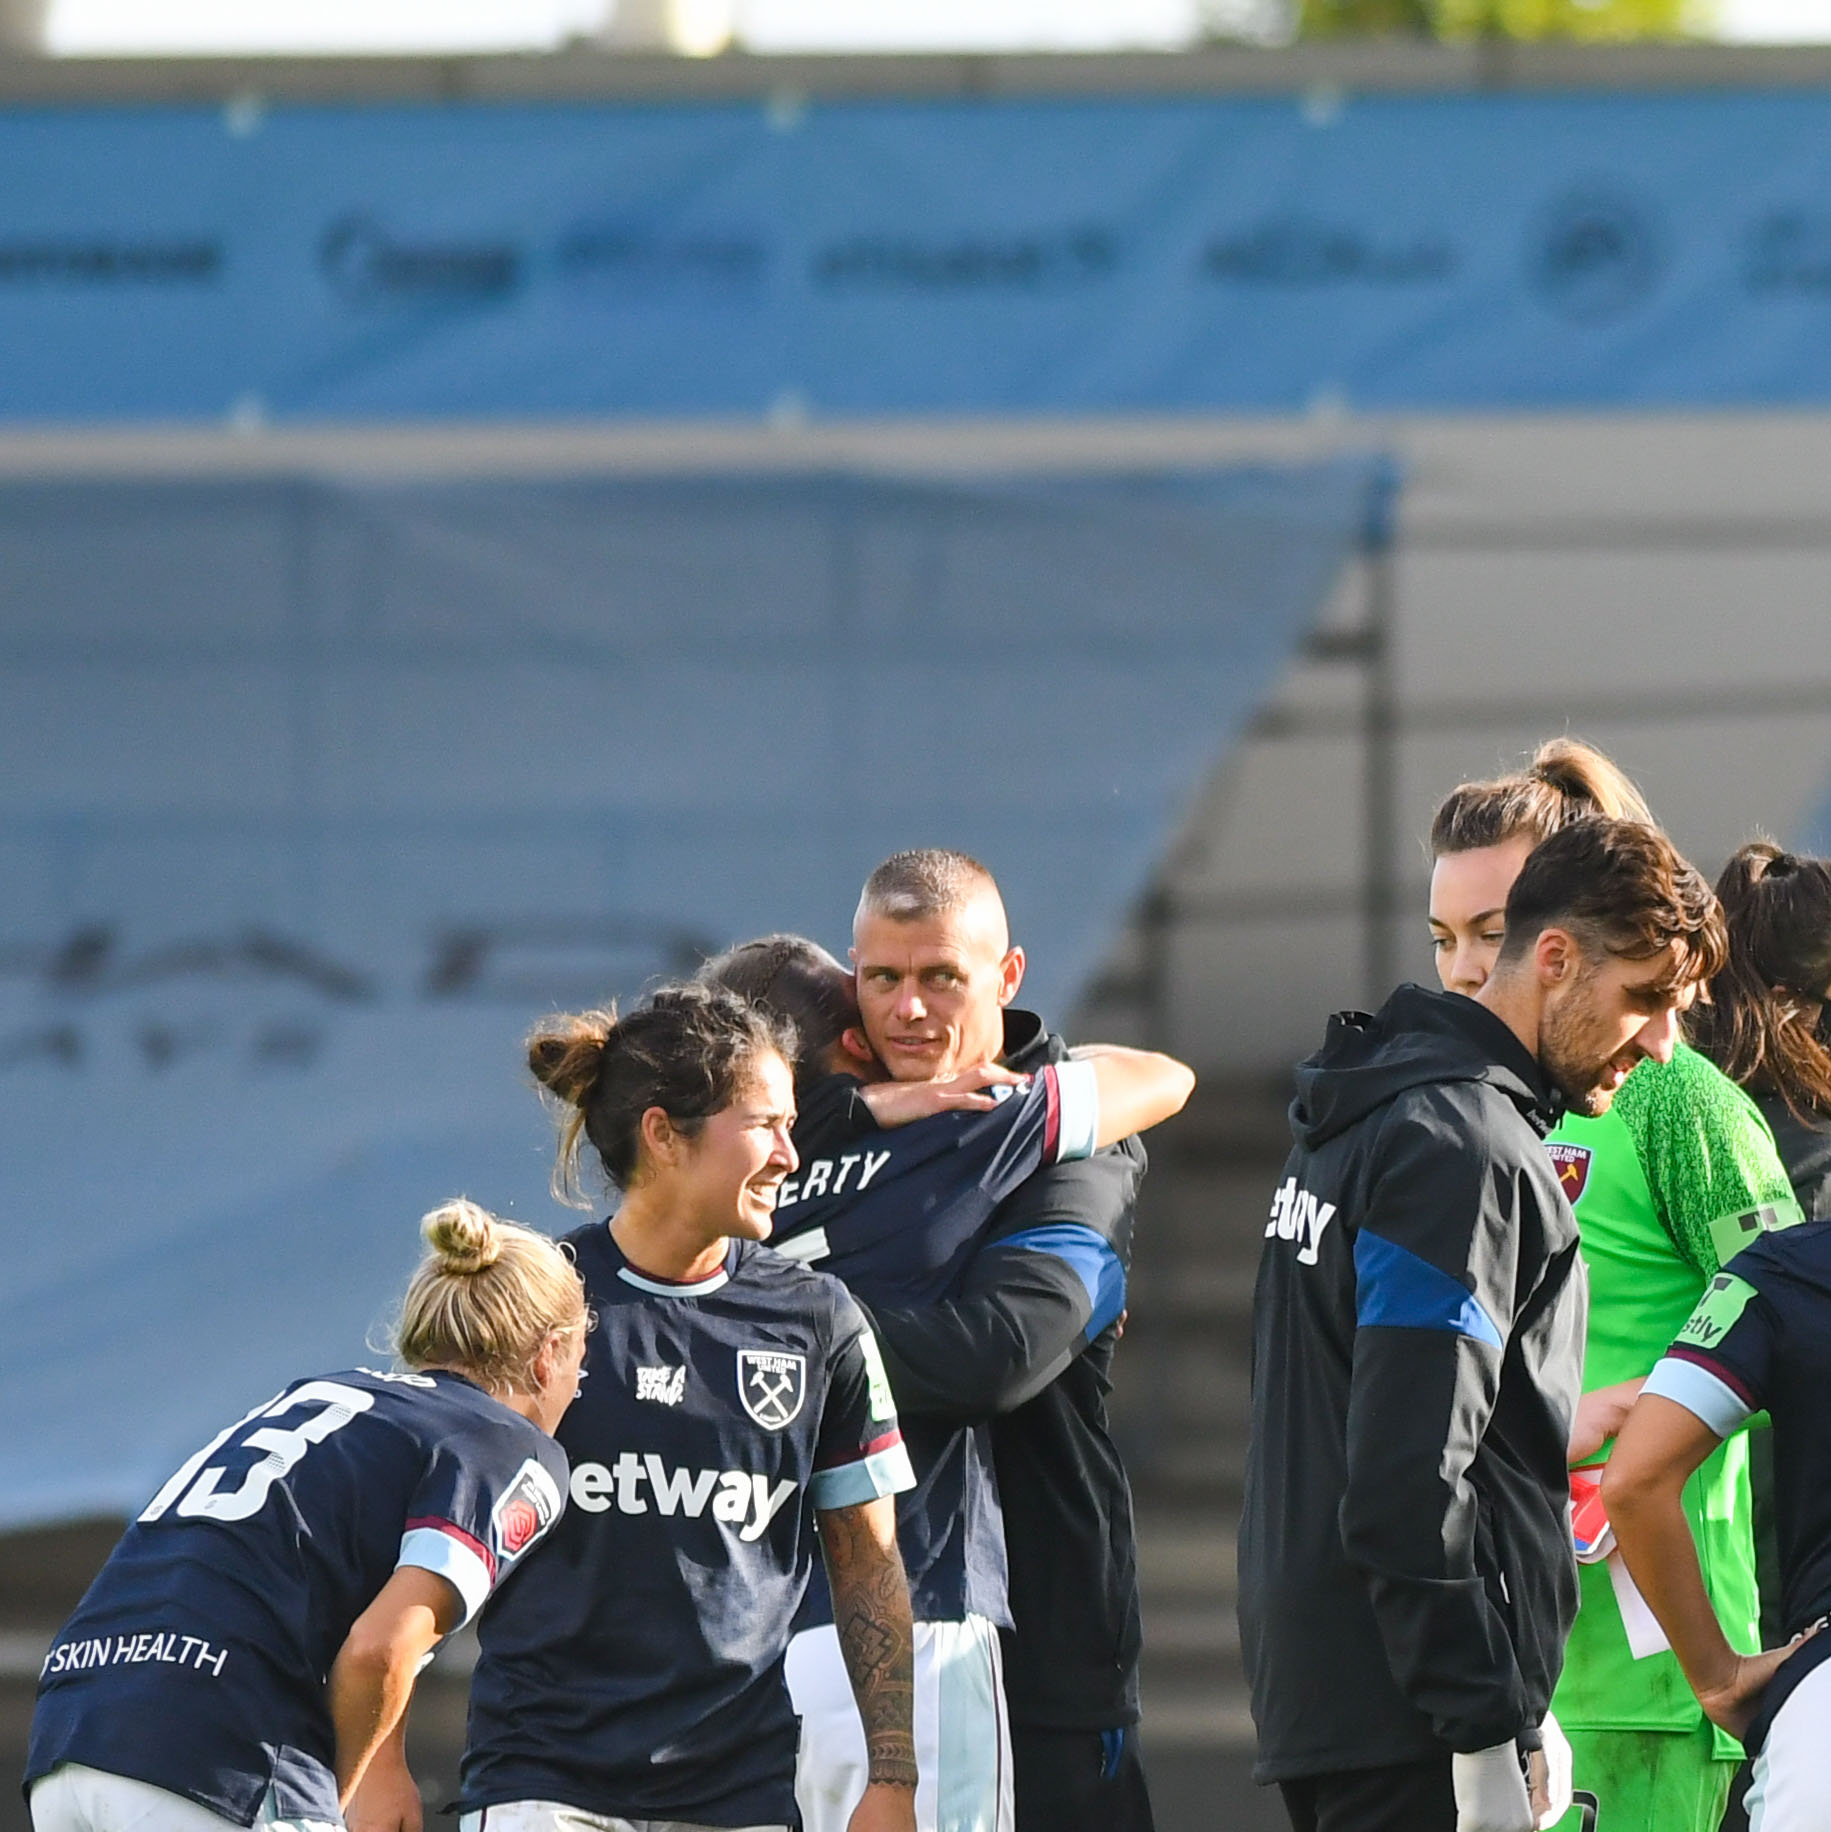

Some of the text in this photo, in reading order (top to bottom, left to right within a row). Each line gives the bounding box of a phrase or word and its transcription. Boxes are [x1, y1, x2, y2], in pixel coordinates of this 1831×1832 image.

[1547, 1147, 1563, 1157] EST
[777, 1149, 892, 1210] ERTY
[1681, 1315, 1723, 1341] stly
[136, 1381, 375, 1524] 13
[569, 1452, 799, 1543] etway
[50, 1633, 229, 1677] SKIN HEALTH
